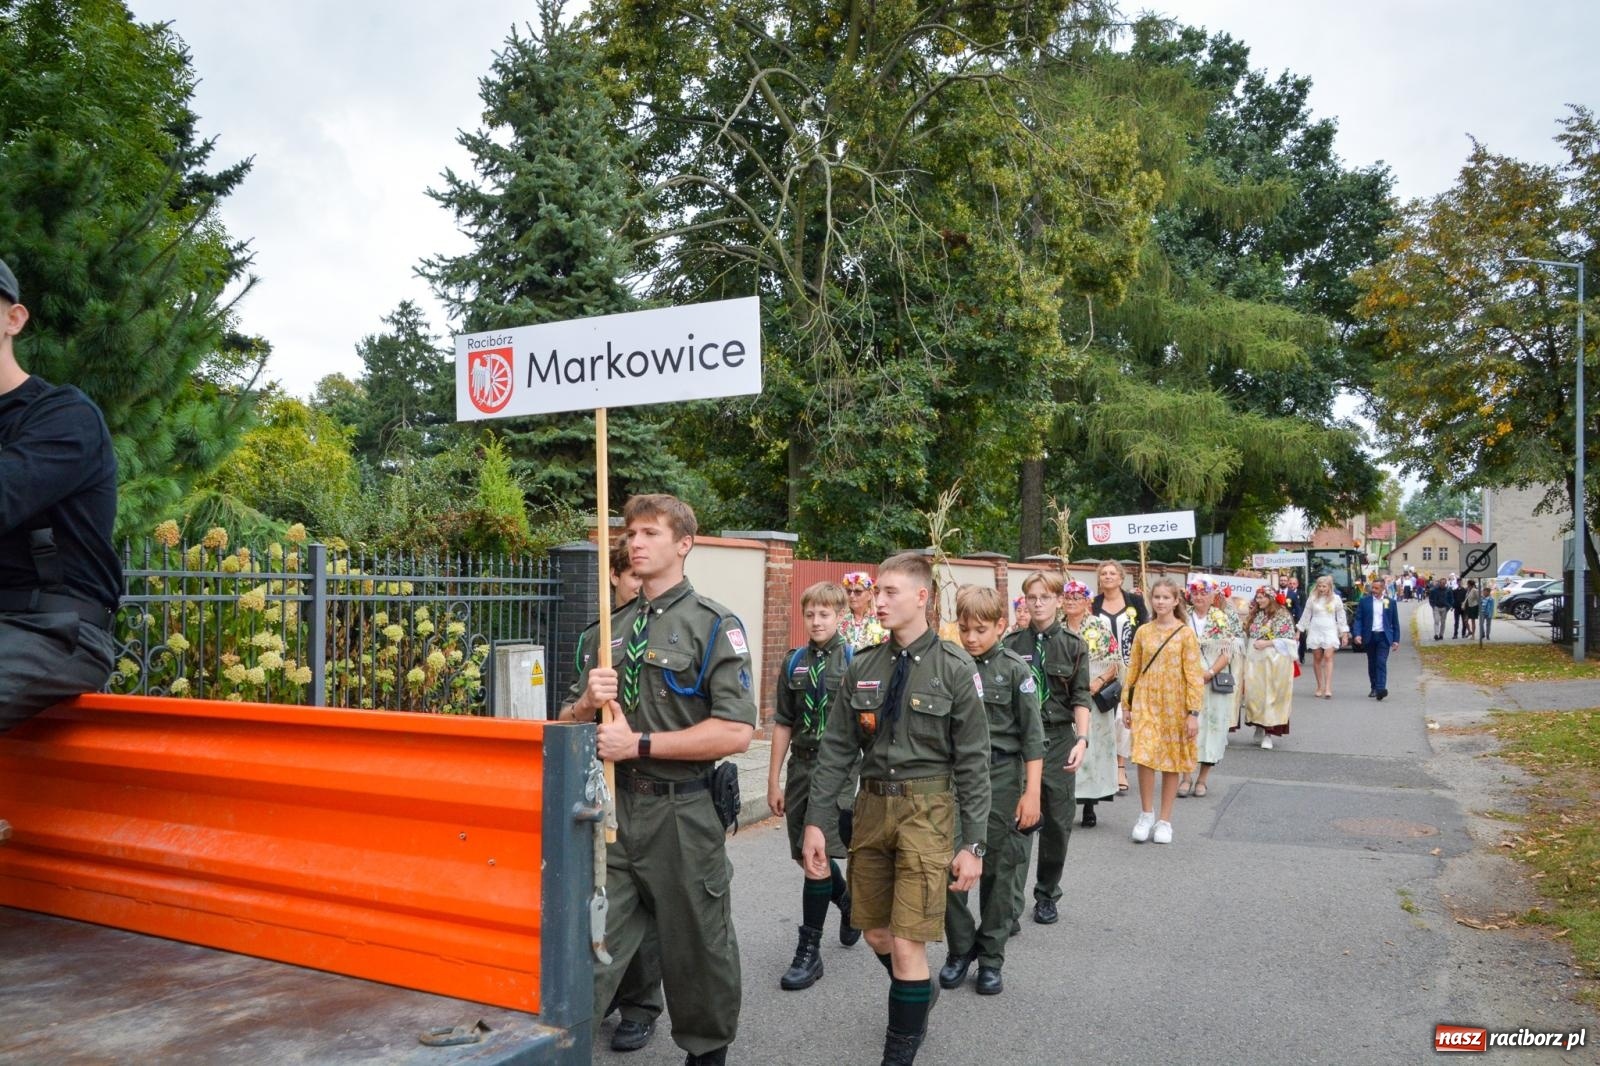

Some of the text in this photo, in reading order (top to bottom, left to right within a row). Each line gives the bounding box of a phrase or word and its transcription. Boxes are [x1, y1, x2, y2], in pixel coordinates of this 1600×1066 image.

[467, 334, 513, 349] Racibórz
[526, 333, 746, 389] Markowice
[1127, 520, 1179, 535] Brzezie
